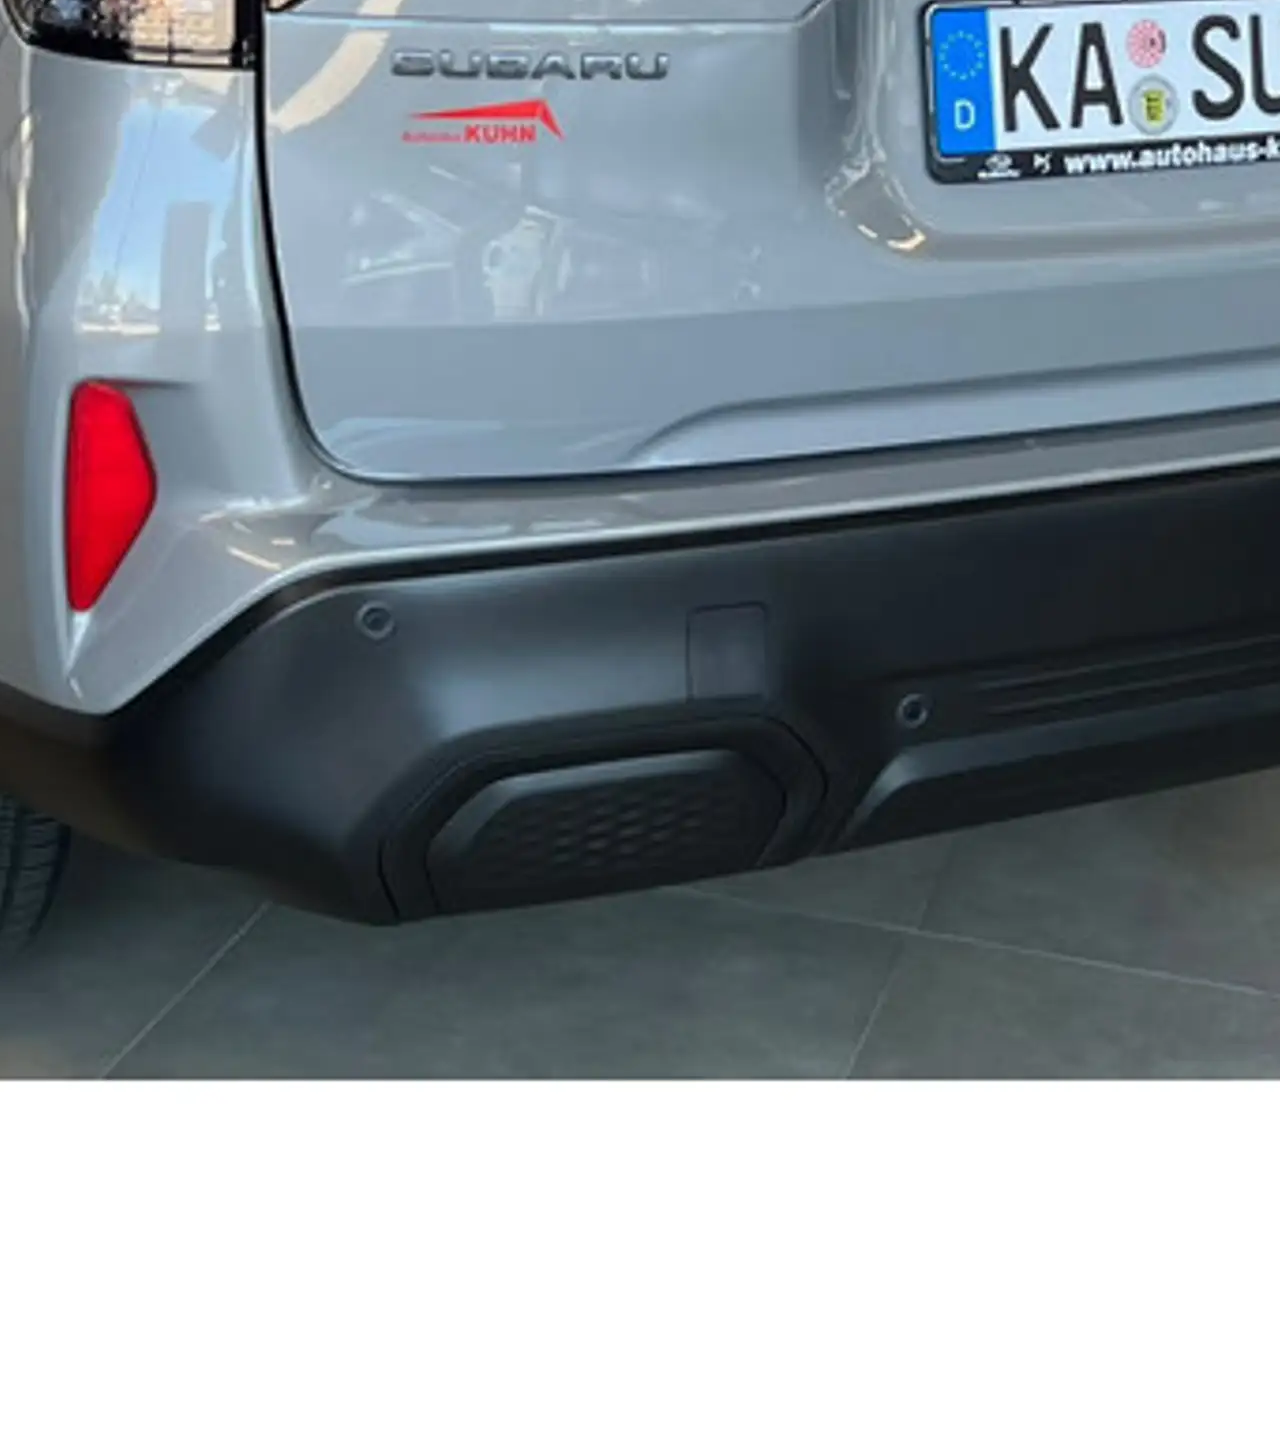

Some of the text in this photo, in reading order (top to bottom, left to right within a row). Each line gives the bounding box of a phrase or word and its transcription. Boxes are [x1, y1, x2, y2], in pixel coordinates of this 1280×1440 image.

[390, 48, 670, 81] SUBARU
[997, 21, 1125, 134] KA
[953, 98, 977, 131] D
[464, 123, 537, 144] KUHN
